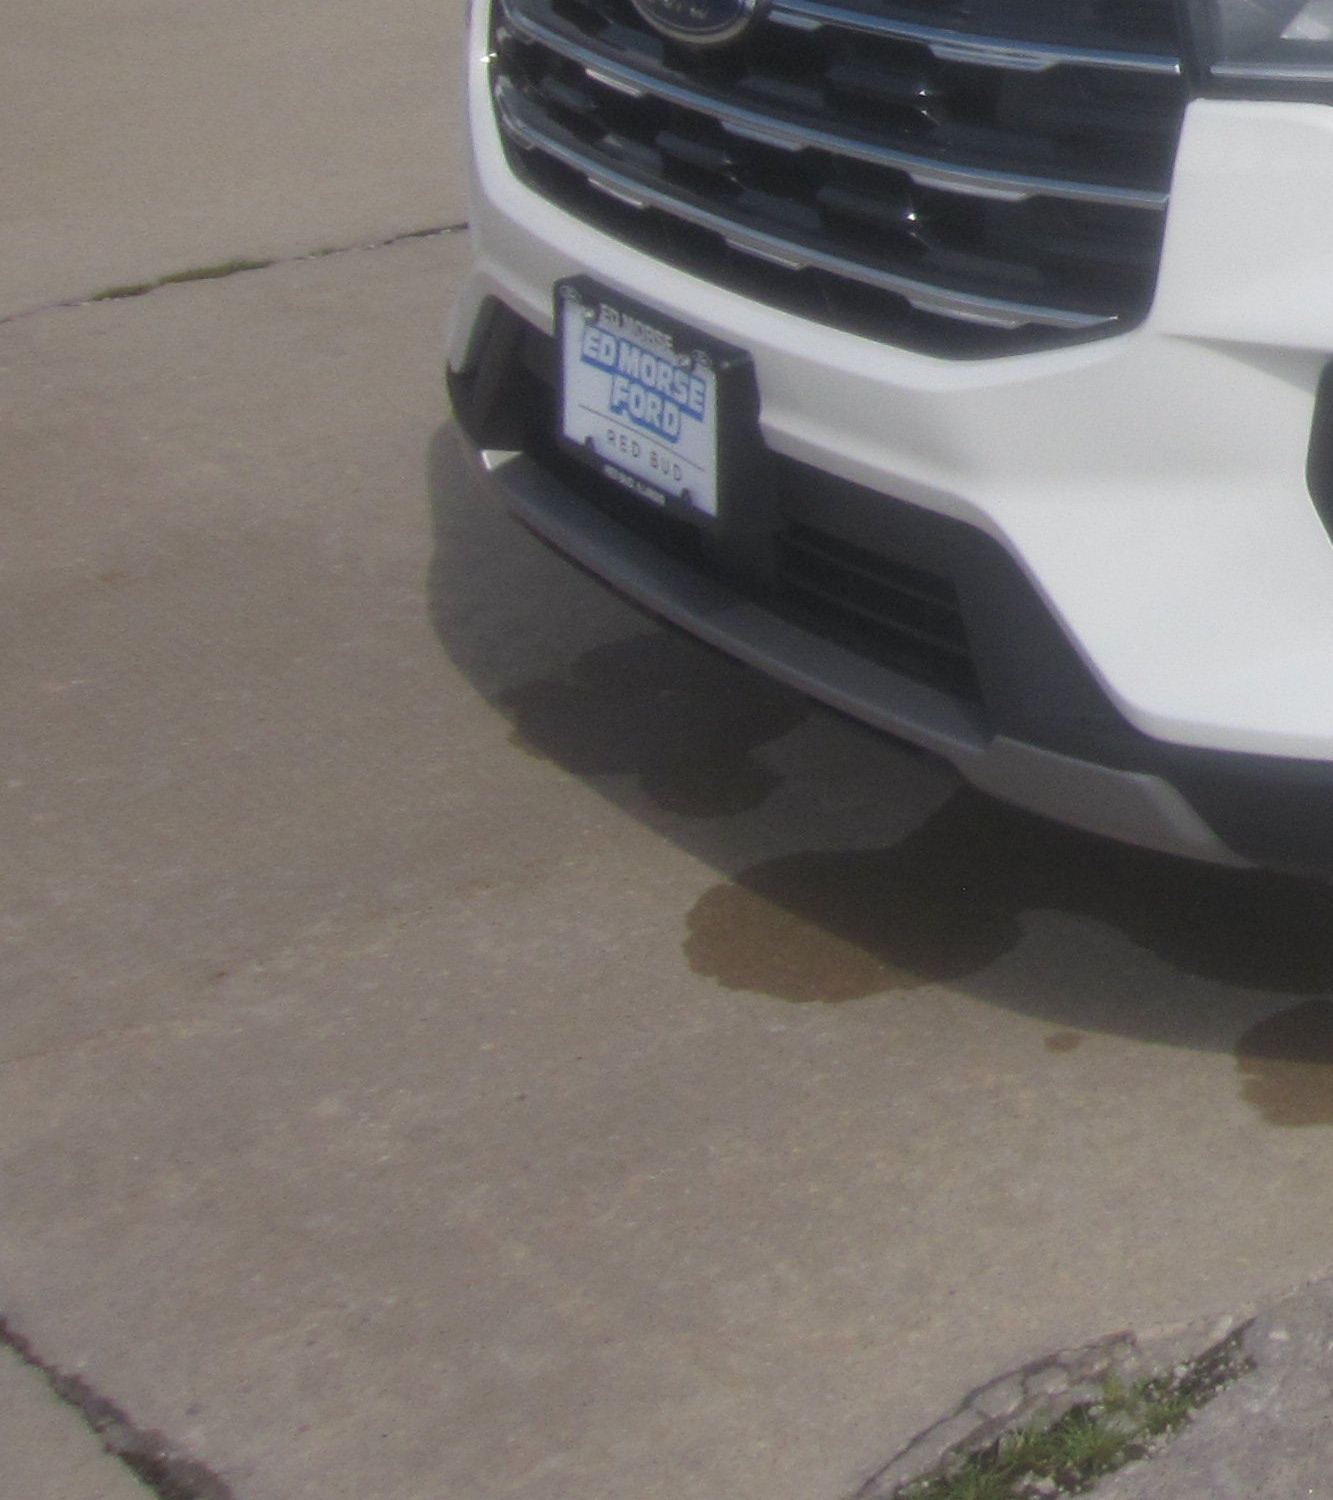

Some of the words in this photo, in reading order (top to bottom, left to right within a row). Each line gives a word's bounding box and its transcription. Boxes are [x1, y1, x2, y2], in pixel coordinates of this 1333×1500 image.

[582, 325, 617, 368] ED
[618, 338, 706, 416] MORSE
[611, 374, 681, 441] FORD
[607, 428, 641, 458] RED
[650, 452, 683, 482] BUD
